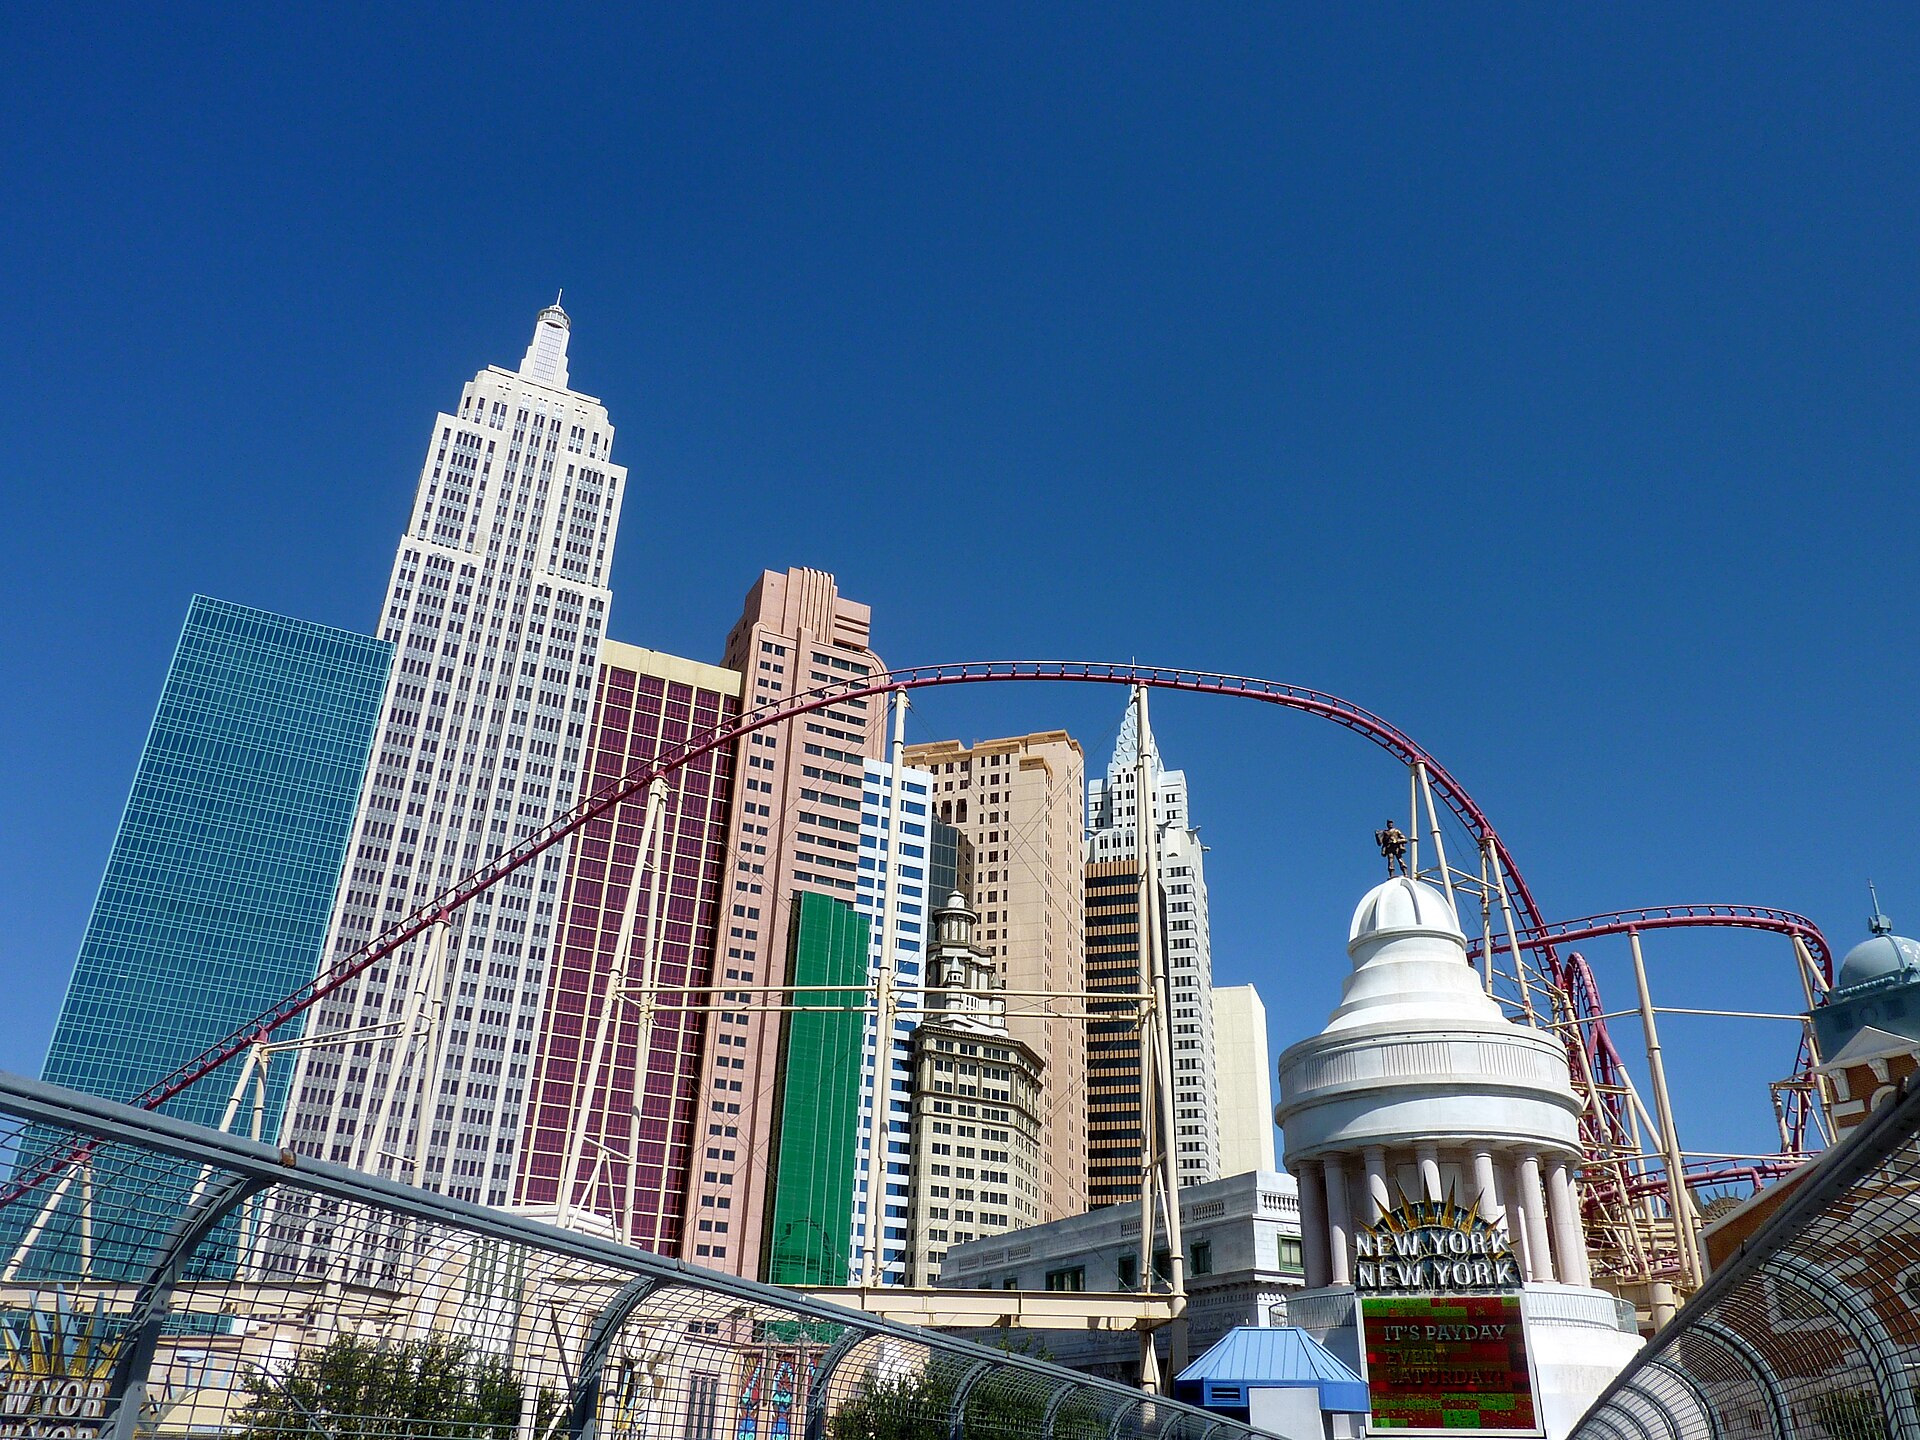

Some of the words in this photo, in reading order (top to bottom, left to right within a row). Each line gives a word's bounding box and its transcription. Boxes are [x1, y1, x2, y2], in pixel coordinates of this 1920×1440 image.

[1356, 1231, 1420, 1256] NEW
[1430, 1228, 1509, 1254] YORK
[1358, 1261, 1424, 1287] NEW
[1433, 1259, 1516, 1285] YORK
[1384, 1325, 1420, 1341] IT'S
[1425, 1324, 1506, 1340] PAYDAY
